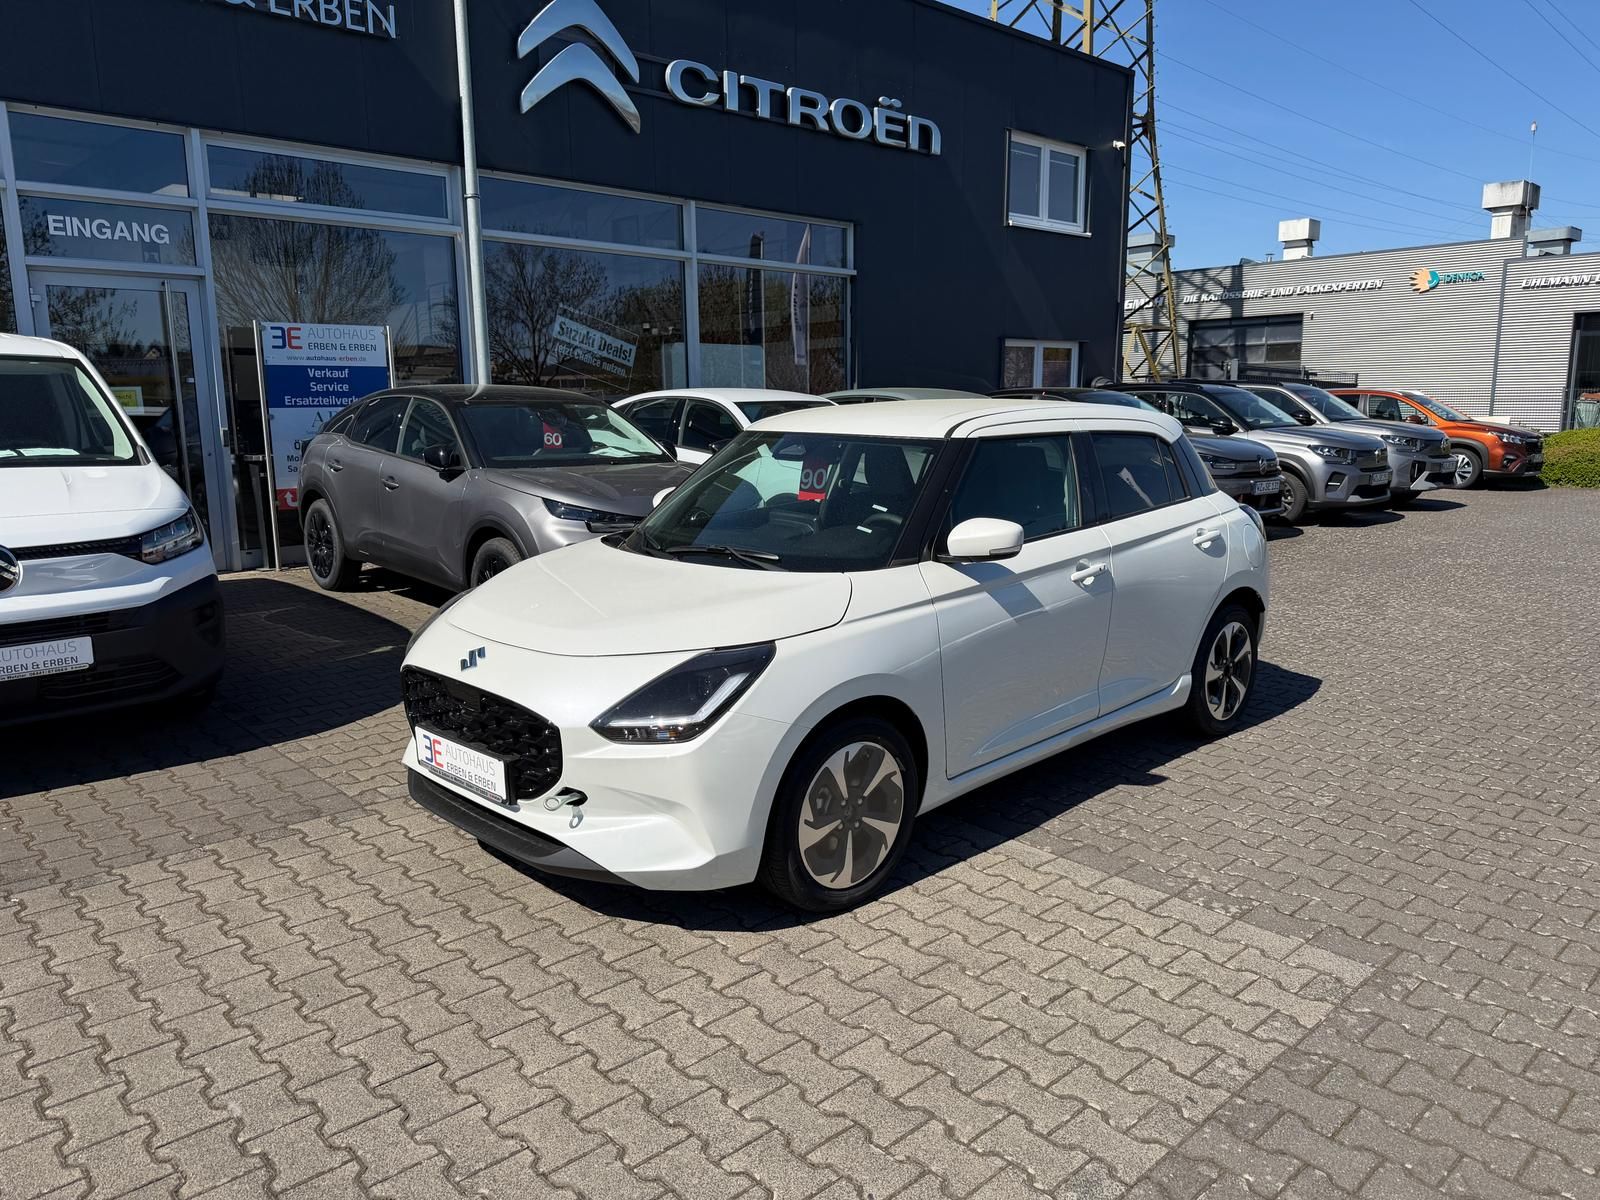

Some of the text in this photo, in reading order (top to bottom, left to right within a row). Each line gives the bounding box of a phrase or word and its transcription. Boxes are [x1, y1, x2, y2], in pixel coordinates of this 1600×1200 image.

[47, 215, 169, 244] EINGANG
[1183, 294, 1199, 304] DIE
[1271, 286, 1294, 297] UND
[1296, 279, 1384, 295] LACKEXPERTEN
[307, 327, 376, 340] AUTOHAUS
[558, 320, 632, 362] Suzuki Deals!
[308, 342, 377, 352] ERBEN & ERBEN
[307, 368, 350, 378] Verkauf
[310, 382, 350, 392] Service
[544, 432, 562, 446] 60
[800, 468, 827, 490] 90
[0, 640, 77, 662] UTOHAUS
[32, 661, 40, 670] &
[43, 655, 79, 668] ERBEN
[445, 743, 496, 776] AUTOHAUS
[446, 763, 467, 780] ERBEN
[468, 771, 473, 782] &
[474, 773, 496, 792] ERBEN
